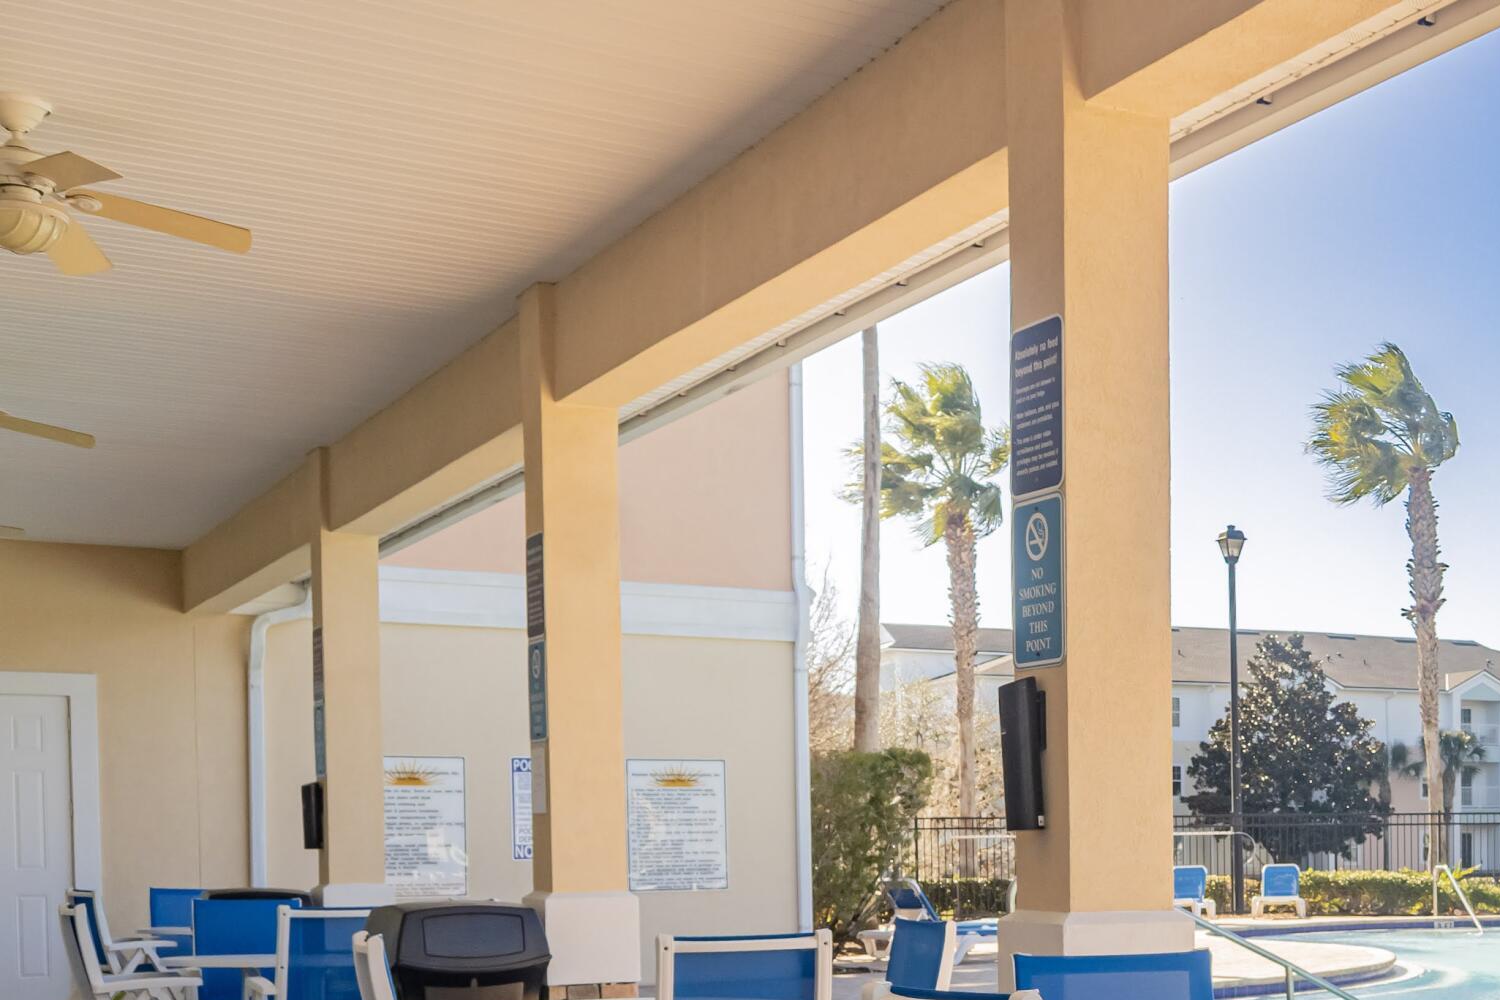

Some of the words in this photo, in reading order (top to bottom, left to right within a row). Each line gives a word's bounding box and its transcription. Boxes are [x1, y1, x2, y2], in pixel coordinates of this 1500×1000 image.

[1031, 567, 1044, 580] NO
[1018, 582, 1057, 600] SMOKING
[1022, 601, 1055, 618] BEYOND
[1029, 620, 1048, 634] THIS
[1025, 637, 1052, 652] POINT
